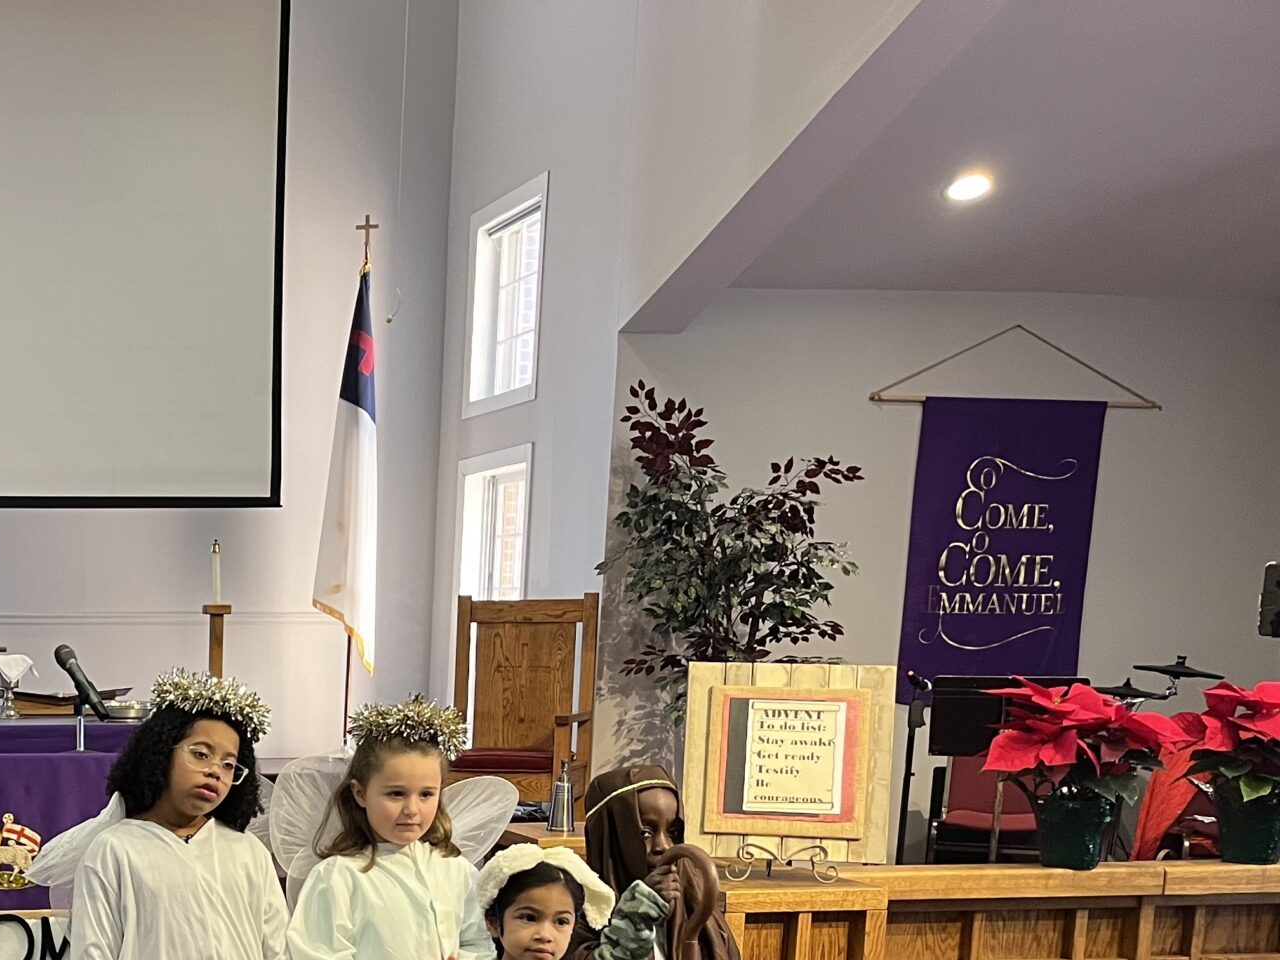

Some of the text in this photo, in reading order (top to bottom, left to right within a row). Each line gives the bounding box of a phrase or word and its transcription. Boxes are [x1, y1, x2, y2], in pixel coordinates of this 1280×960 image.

[956, 487, 1054, 532] COME,
[938, 542, 1061, 592] COME,
[926, 585, 1066, 616] EMMANUEL
[762, 709, 825, 720] ADVENT
[757, 721, 827, 732] To do list:
[758, 736, 784, 748] Stay
[756, 750, 821, 764] Get ready
[756, 764, 800, 778] Testify
[756, 779, 772, 788] Be
